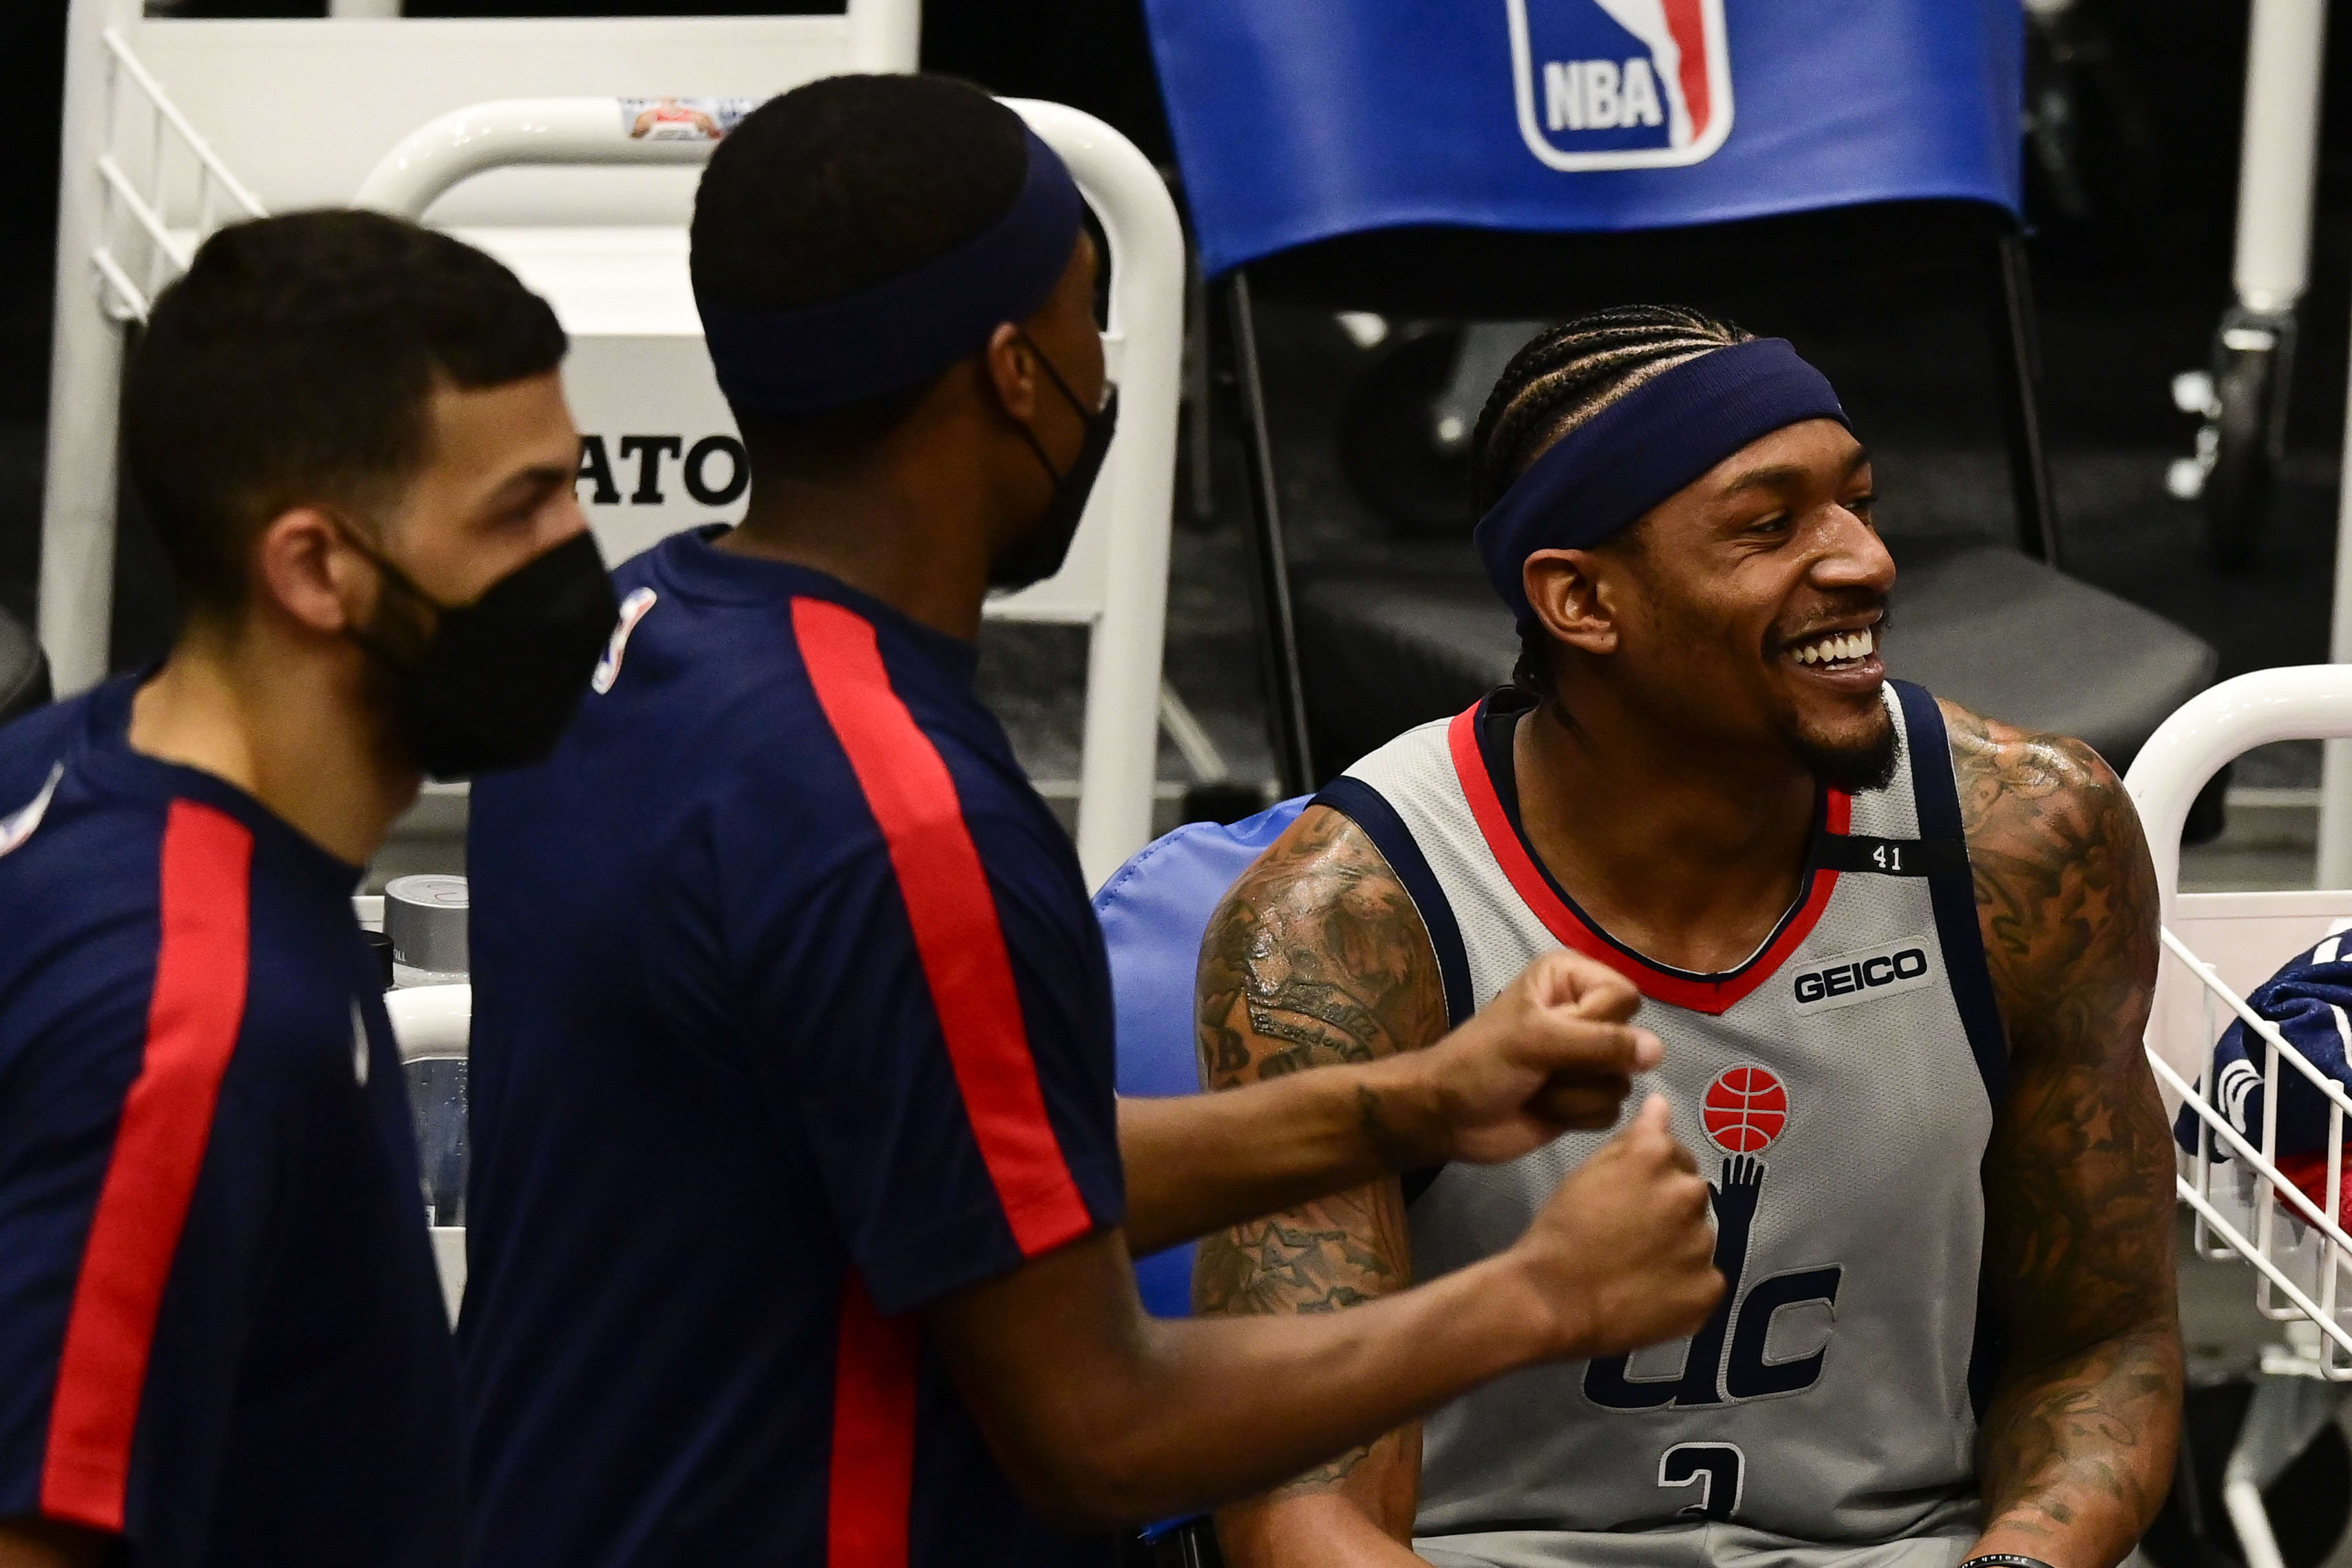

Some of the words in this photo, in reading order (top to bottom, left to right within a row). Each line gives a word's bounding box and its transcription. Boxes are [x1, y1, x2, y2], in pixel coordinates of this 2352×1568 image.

[1544, 57, 1664, 131] NBA
[1872, 845, 1901, 871] 41
[1794, 948, 1927, 1004] GEICO
